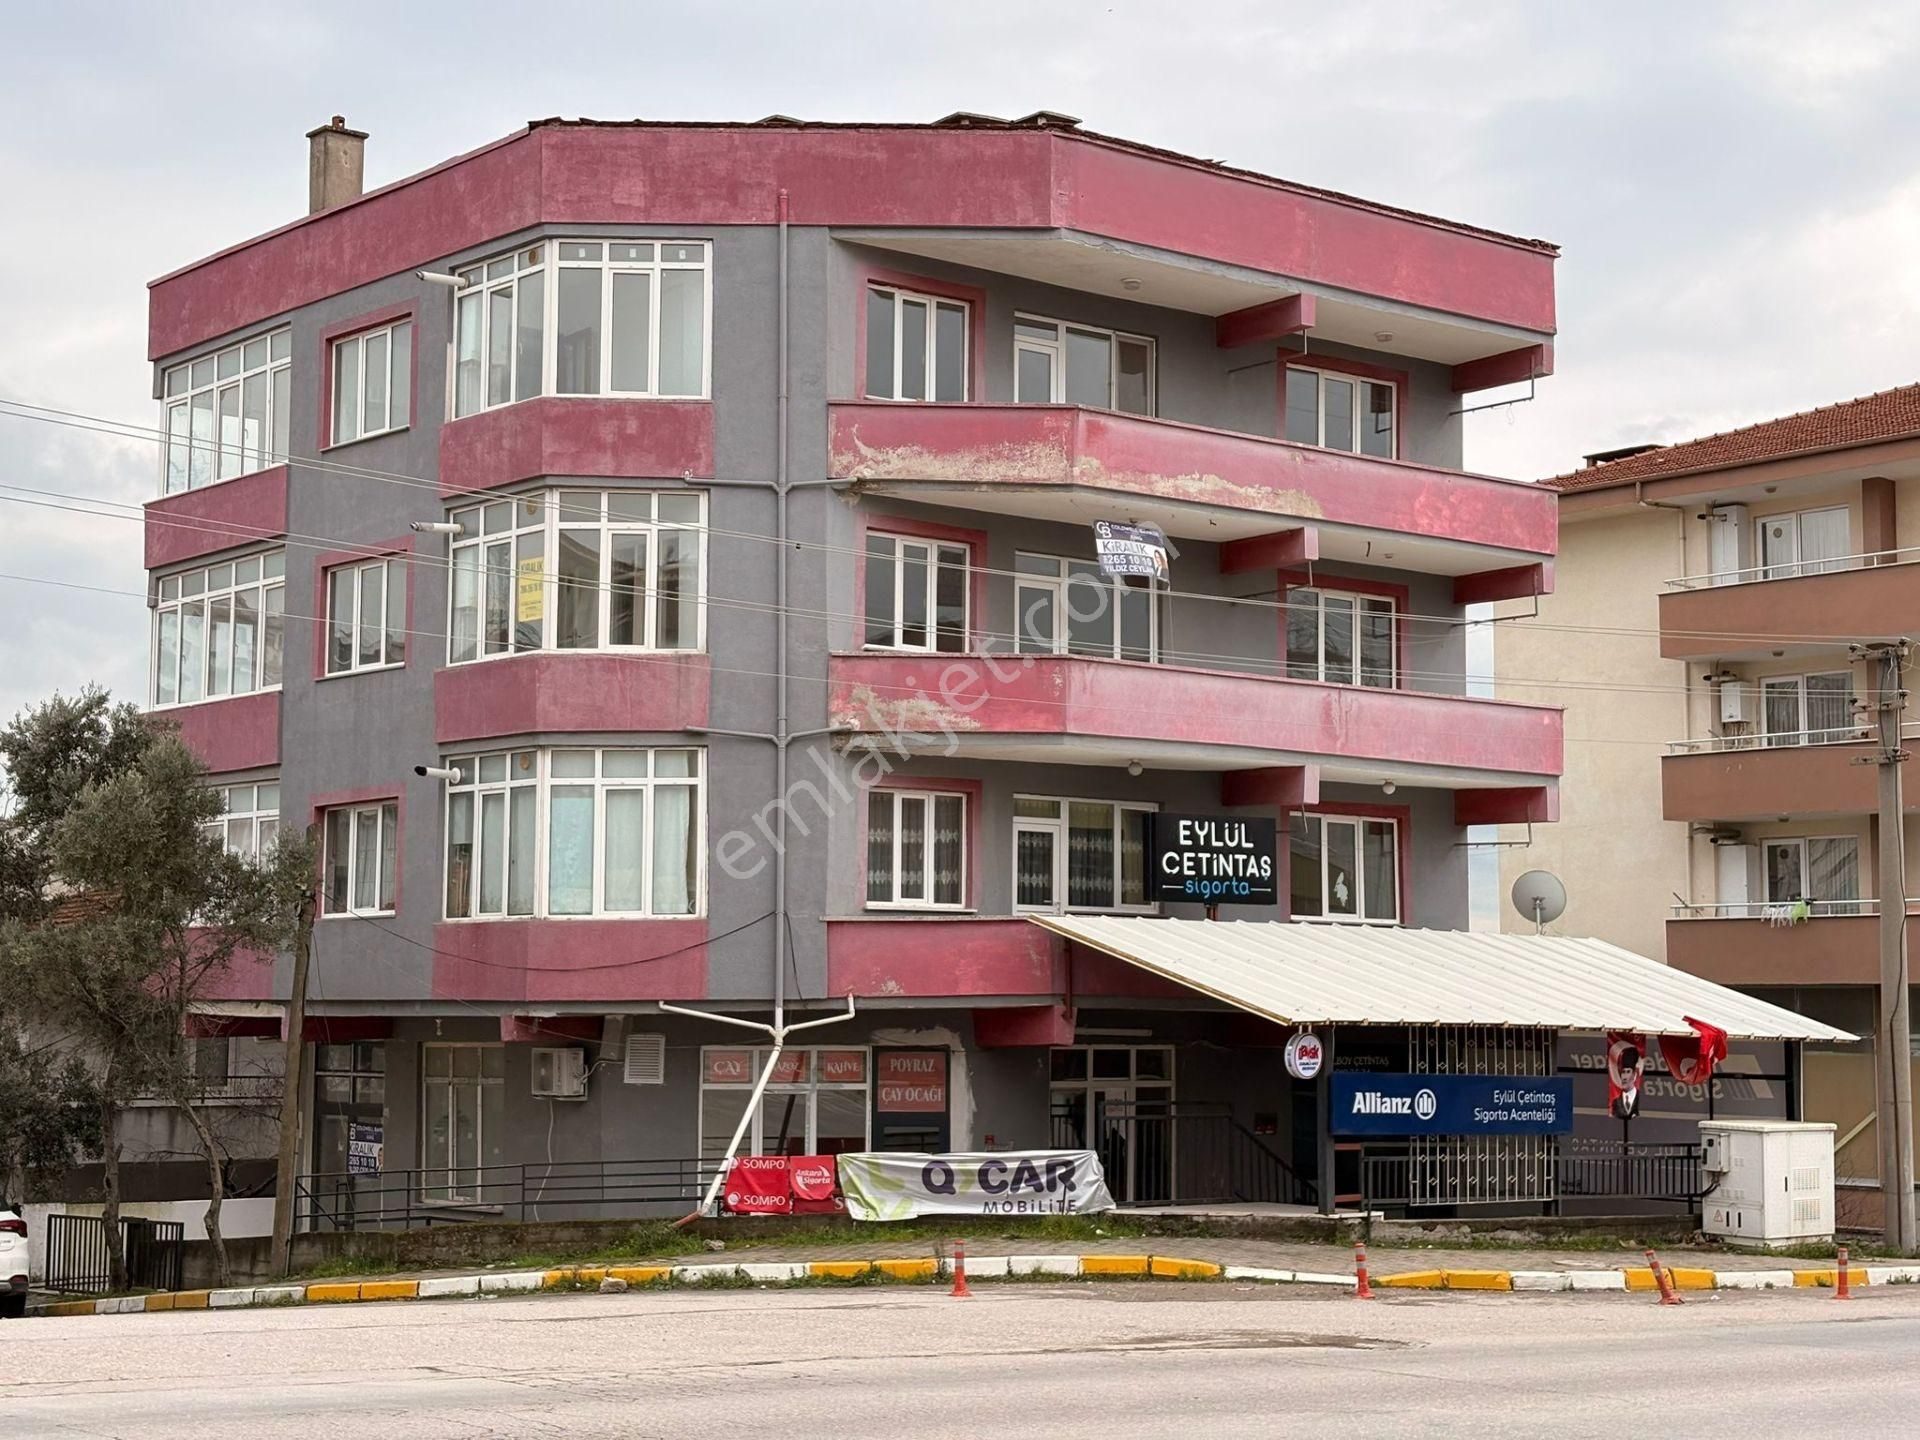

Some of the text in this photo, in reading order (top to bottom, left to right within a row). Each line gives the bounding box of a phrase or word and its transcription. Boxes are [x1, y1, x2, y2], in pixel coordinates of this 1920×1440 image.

[1179, 820, 1254, 848] EYLÜL
[1185, 877, 1250, 899] sigorta
[713, 1060, 742, 1076] ÇAY
[827, 1062, 860, 1074] KAHVE
[890, 1058, 935, 1073] POYRAZ
[882, 1085, 942, 1103] ÇAY OCAĞI
[1493, 1090, 1556, 1106] Eylül Çetintaş
[1352, 1092, 1411, 1114] Allianz
[1474, 1108, 1556, 1123] Sigorta Acenteliği
[743, 1159, 785, 1169] SOMPO
[978, 1159, 1077, 1194] CAR
[743, 1195, 785, 1206] SOMPO
